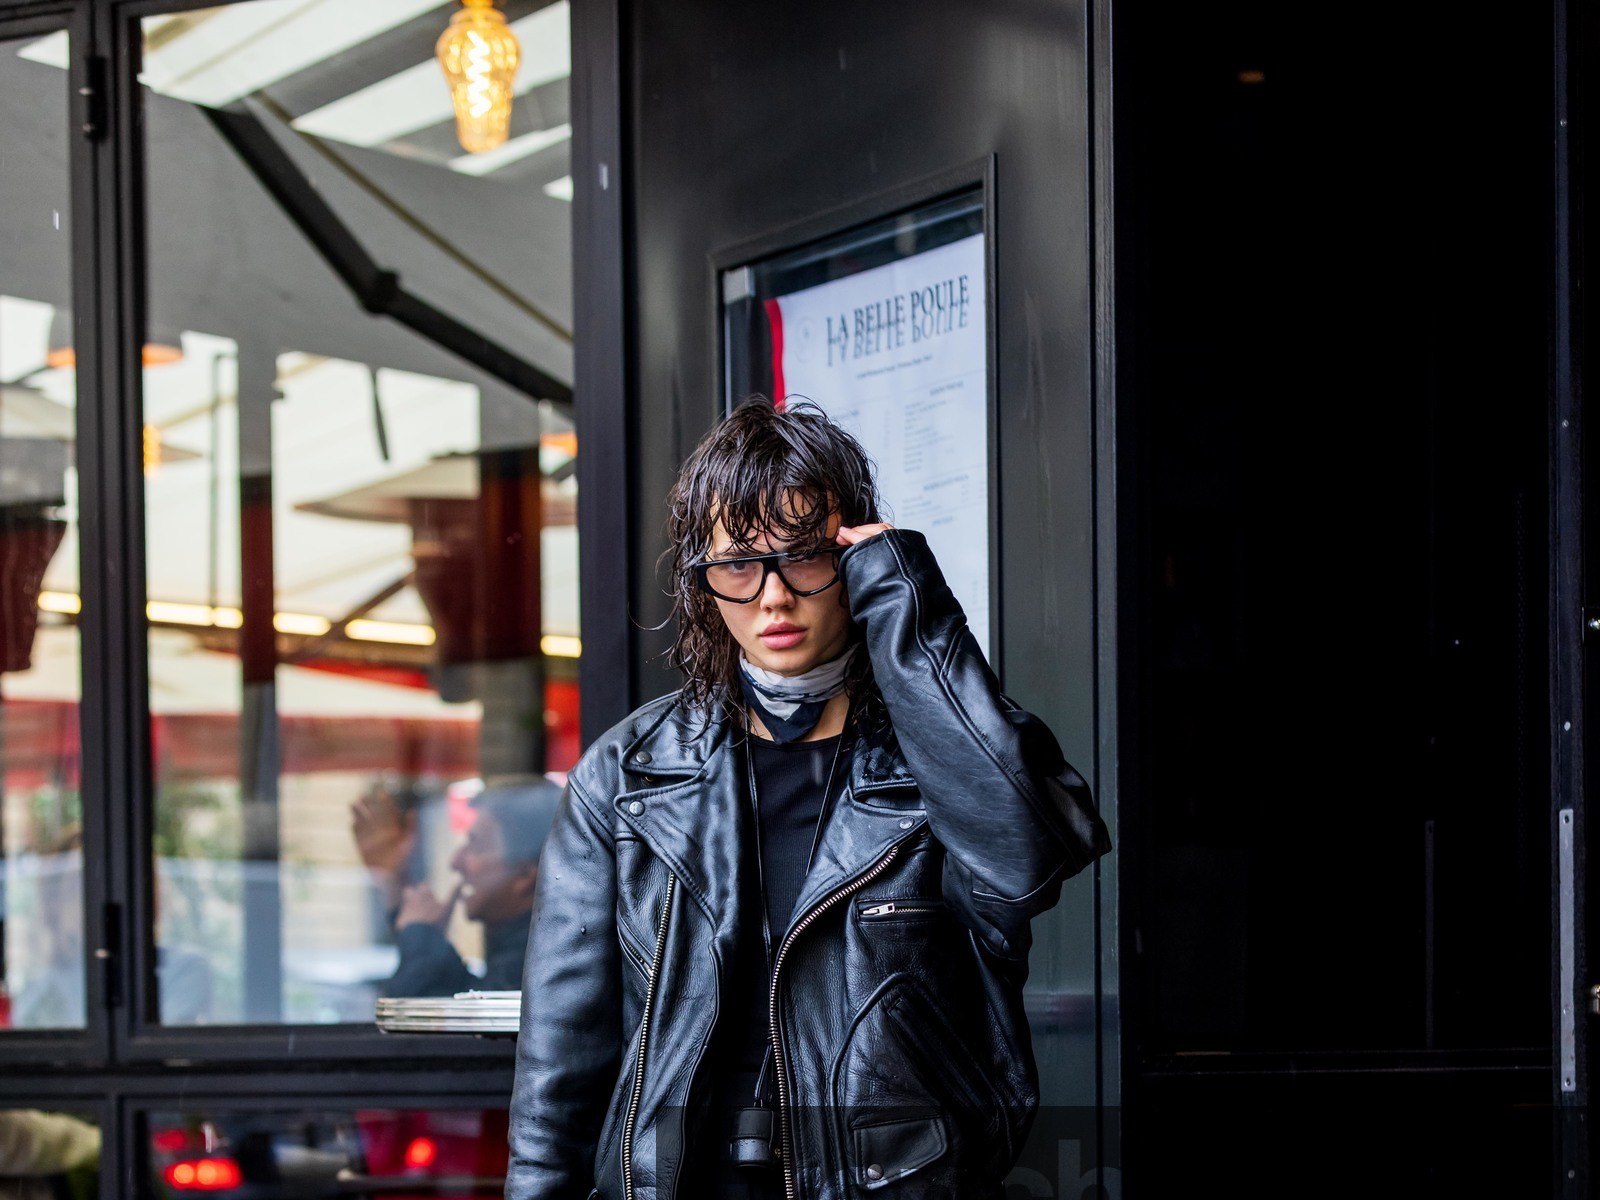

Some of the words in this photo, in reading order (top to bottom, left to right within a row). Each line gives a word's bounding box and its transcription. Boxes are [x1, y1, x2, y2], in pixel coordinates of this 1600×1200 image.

[826, 315, 849, 344] LA
[854, 295, 905, 335] BELLE
[910, 276, 969, 321] POULE
